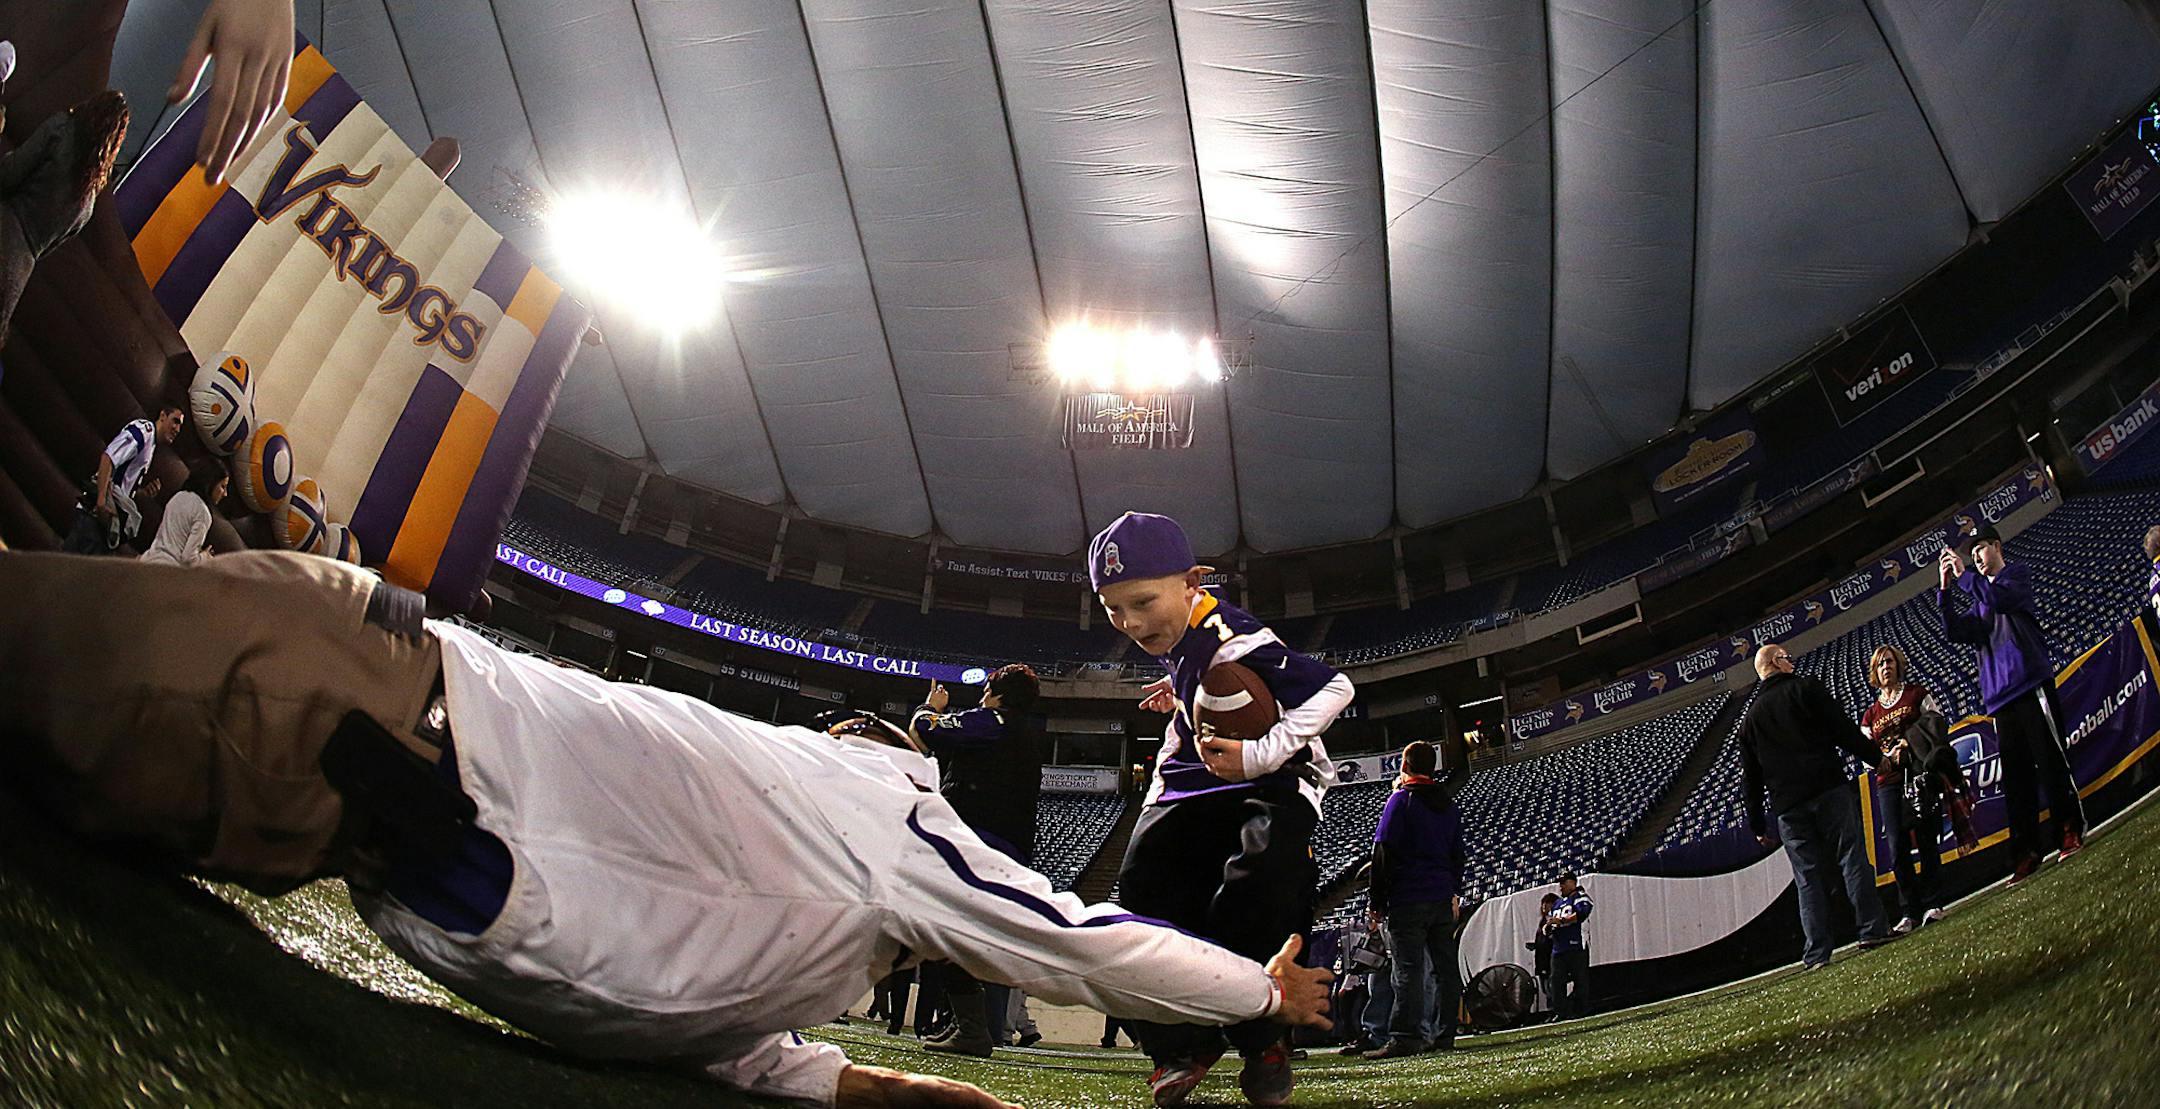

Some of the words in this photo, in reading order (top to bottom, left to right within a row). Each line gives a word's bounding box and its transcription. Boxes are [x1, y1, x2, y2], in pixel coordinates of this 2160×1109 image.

[2118, 186, 2141, 208] FIELD
[253, 120, 487, 363] VIKINGS
[1844, 351, 1914, 402] verizon
[1077, 422, 1105, 433] MALL
[1107, 422, 1123, 433] OF
[1124, 420, 1179, 433] AMERICA
[1112, 433, 1147, 444] FIELD
[1978, 483, 2018, 521] LEGENDS
[1987, 493, 2018, 523] CLUB
[1906, 528, 1948, 564] LEGENDS
[526, 559, 568, 586] CALL
[947, 561, 966, 572] Fan
[968, 563, 1004, 577] Assist:
[1006, 567, 1029, 579] Text
[1830, 571, 1873, 607] LEGENDS
[1837, 581, 1871, 611] CLUB
[1752, 612, 1795, 646] LEGENDS
[690, 614, 736, 638] LAST
[739, 627, 816, 659] SEASON,
[822, 648, 868, 668] LAST
[873, 657, 921, 676] CALL
[720, 664, 736, 676] 55
[740, 667, 800, 691] STUDWELL
[1676, 648, 1719, 679] LEGENDS
[1682, 657, 1717, 684] CLUB
[1593, 680, 1637, 709] LEGENDS
[1600, 690, 1633, 714] CLUB
[1511, 709, 1554, 734] LEGENDS
[1517, 718, 1551, 740] CLUB
